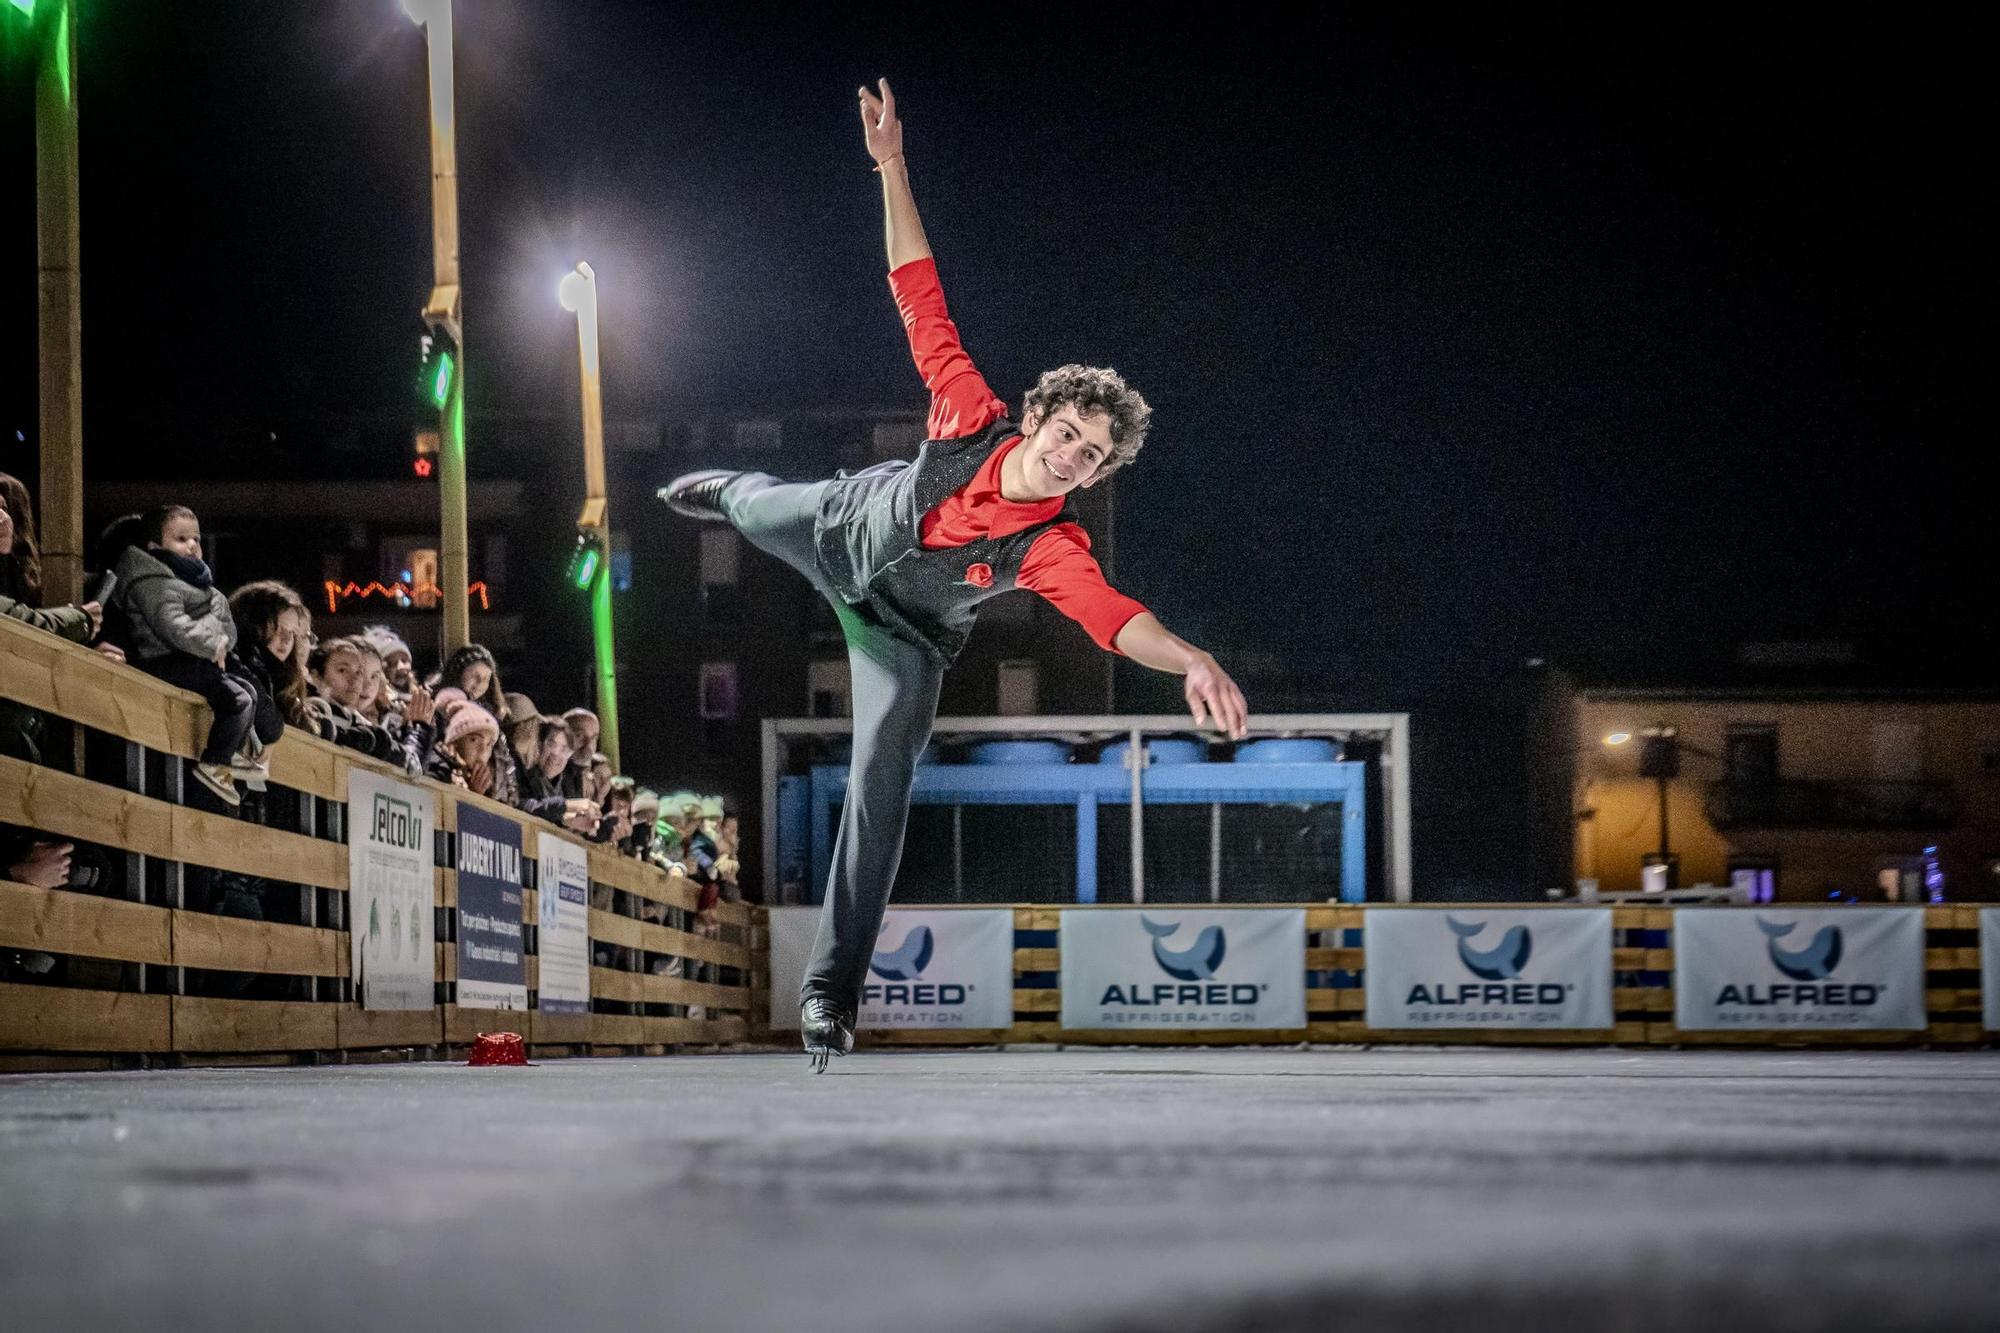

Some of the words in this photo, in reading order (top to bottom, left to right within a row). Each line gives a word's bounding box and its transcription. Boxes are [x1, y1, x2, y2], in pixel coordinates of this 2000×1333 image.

[460, 831, 494, 878] JUBERT
[501, 843, 521, 885] VILA
[861, 984, 966, 1005] FRED
[860, 1012, 963, 1022] IGERATION
[1101, 1012, 1257, 1023] REFRIGERATION
[1408, 1012, 1563, 1023] REFRIGERATION
